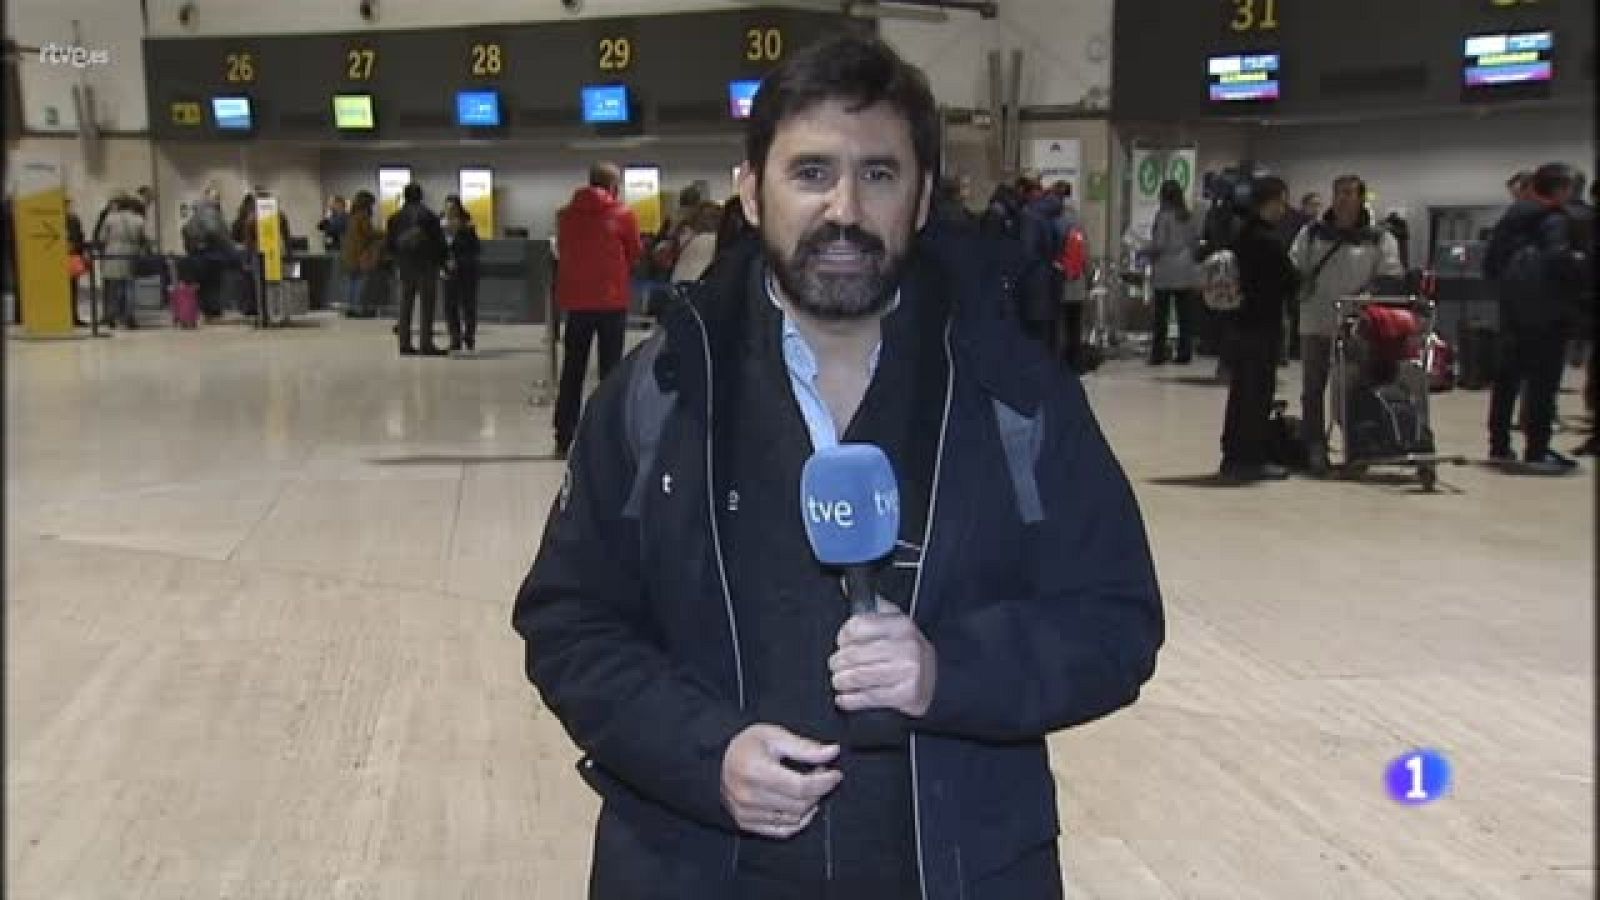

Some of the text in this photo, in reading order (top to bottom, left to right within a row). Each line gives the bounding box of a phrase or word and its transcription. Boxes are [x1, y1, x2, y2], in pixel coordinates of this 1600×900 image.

[1231, 0, 1277, 30] 31
[471, 44, 501, 75] 28
[600, 38, 631, 69] 29
[747, 29, 781, 60] 30
[226, 54, 253, 81] 26
[349, 50, 375, 79] 27
[808, 496, 854, 527] tve
